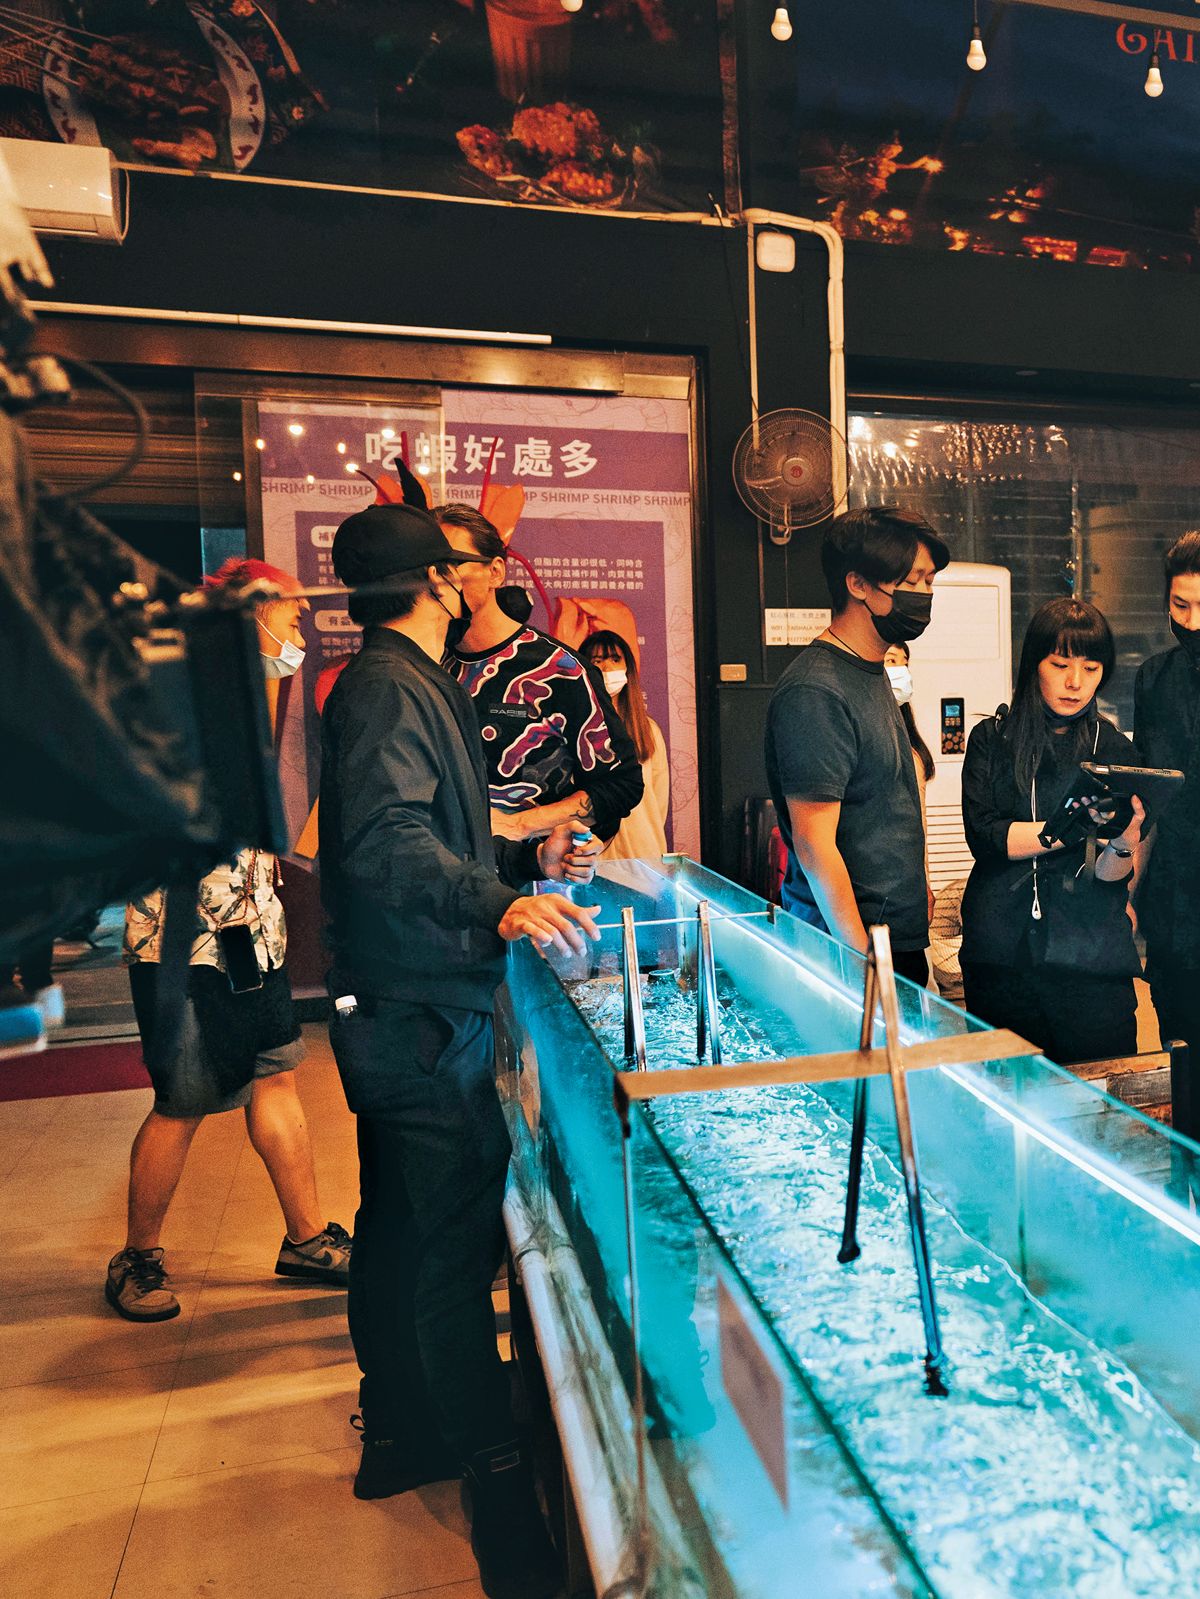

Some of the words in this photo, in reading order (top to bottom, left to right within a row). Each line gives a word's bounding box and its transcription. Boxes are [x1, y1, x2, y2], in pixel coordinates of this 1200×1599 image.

[365, 432, 598, 479] 吃蝦好處多
[261, 482, 315, 494] SHRIMP
[319, 484, 372, 496] SHRIMP
[541, 491, 590, 503] SHRIMP
[593, 493, 641, 505] SHRIMP
[644, 495, 691, 507] SHRIMP
